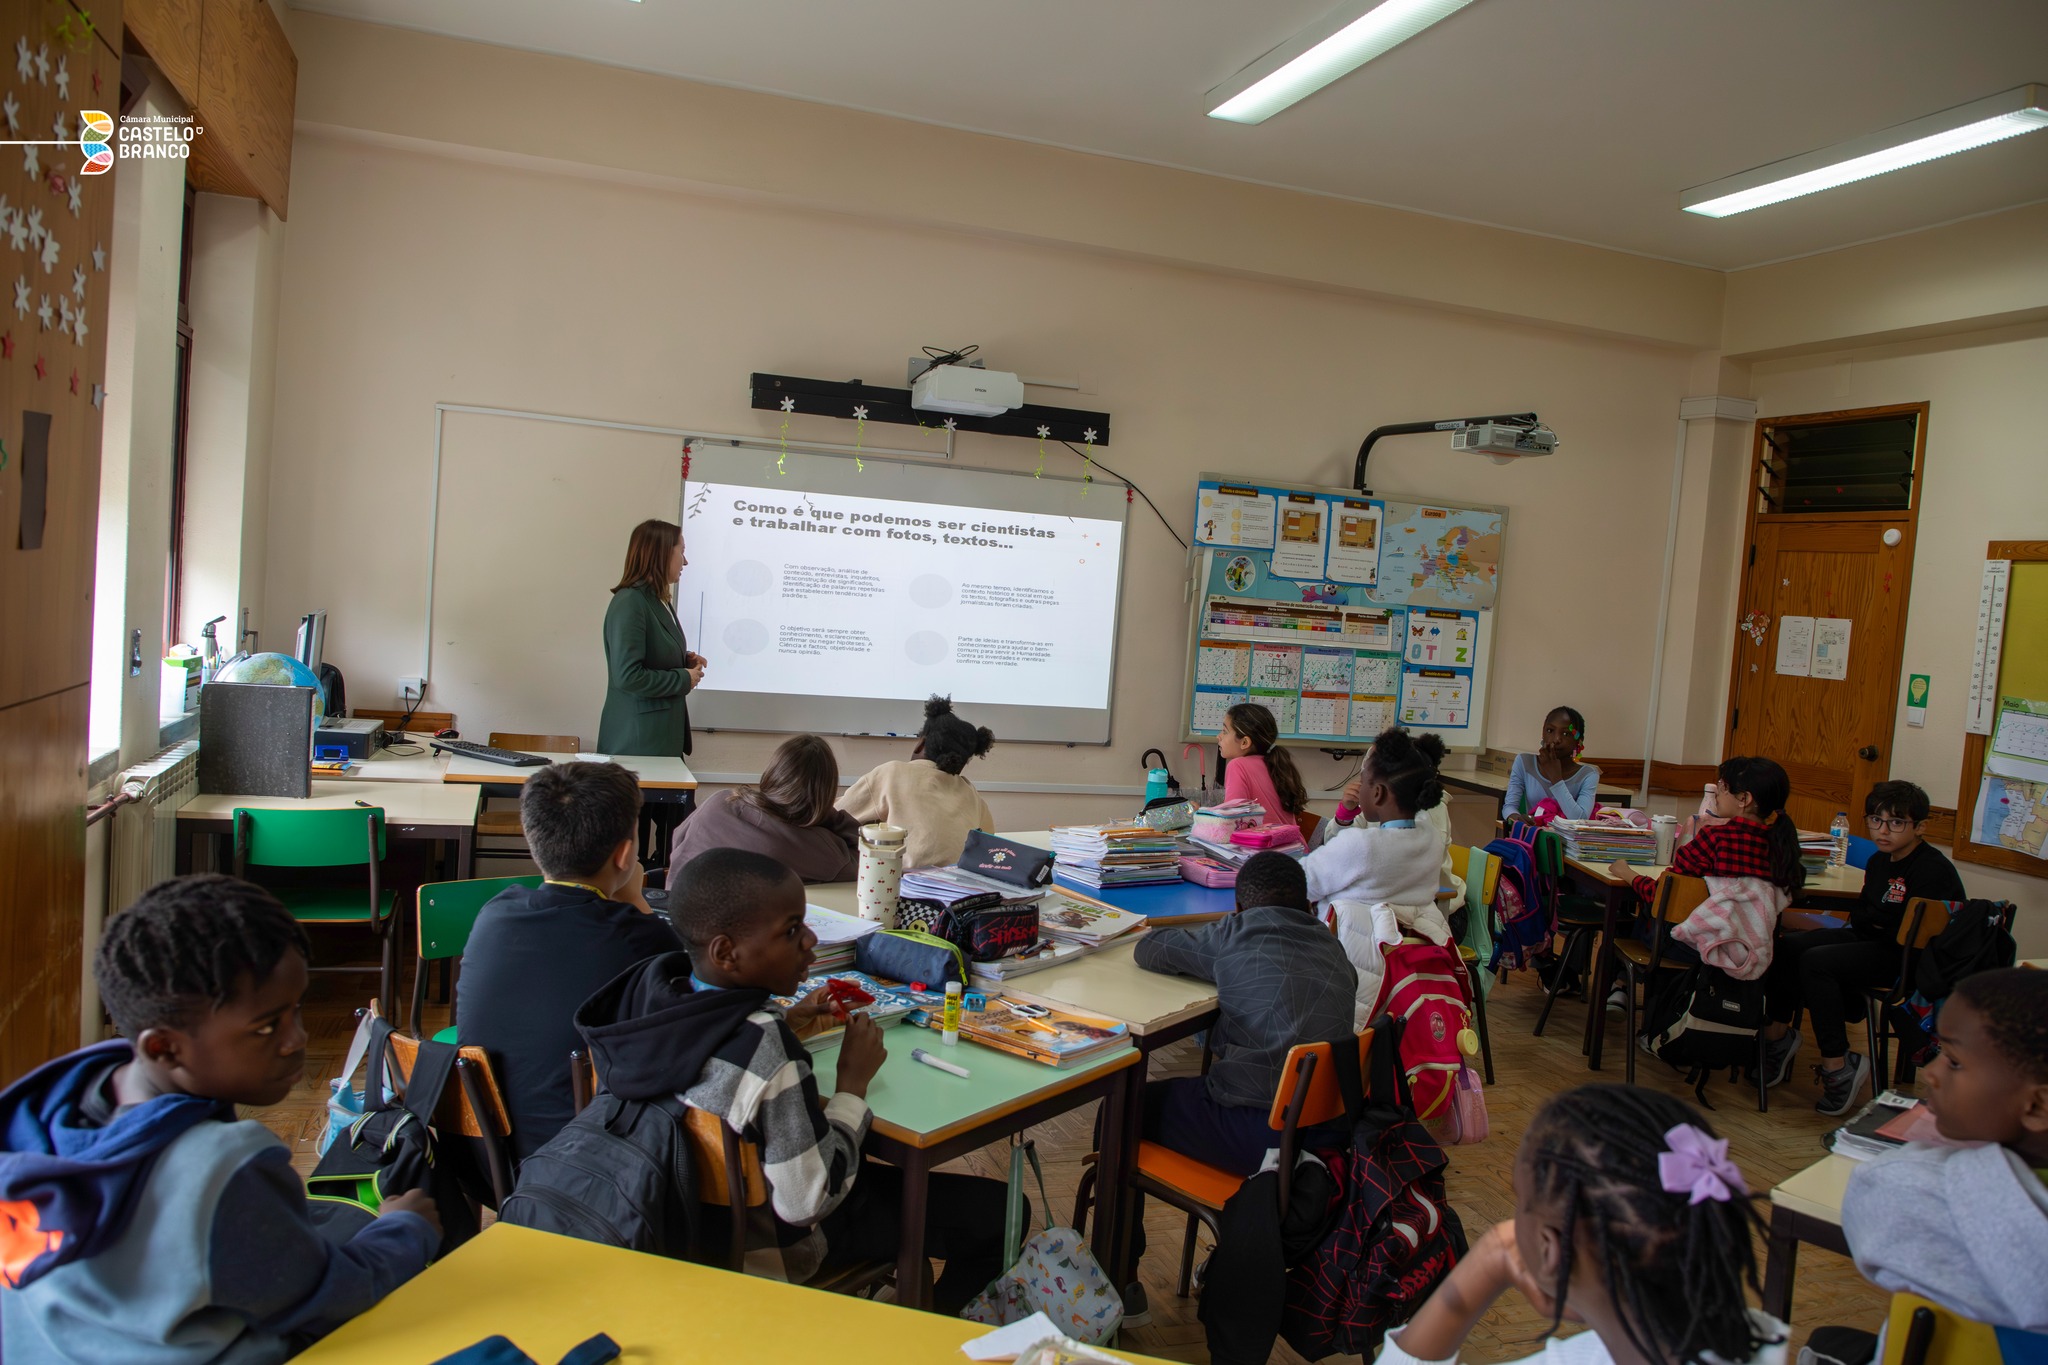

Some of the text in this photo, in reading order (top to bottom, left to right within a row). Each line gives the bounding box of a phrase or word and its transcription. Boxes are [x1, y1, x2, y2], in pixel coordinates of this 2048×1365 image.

[734, 500, 1055, 538] Como é que podemos ser cientistas
[733, 517, 1013, 549] e trabalhar com fotos, textos...
[783, 575, 827, 583] desconstrução
[1455, 647, 1467, 662] Z
[2003, 700, 2019, 708] Maio
